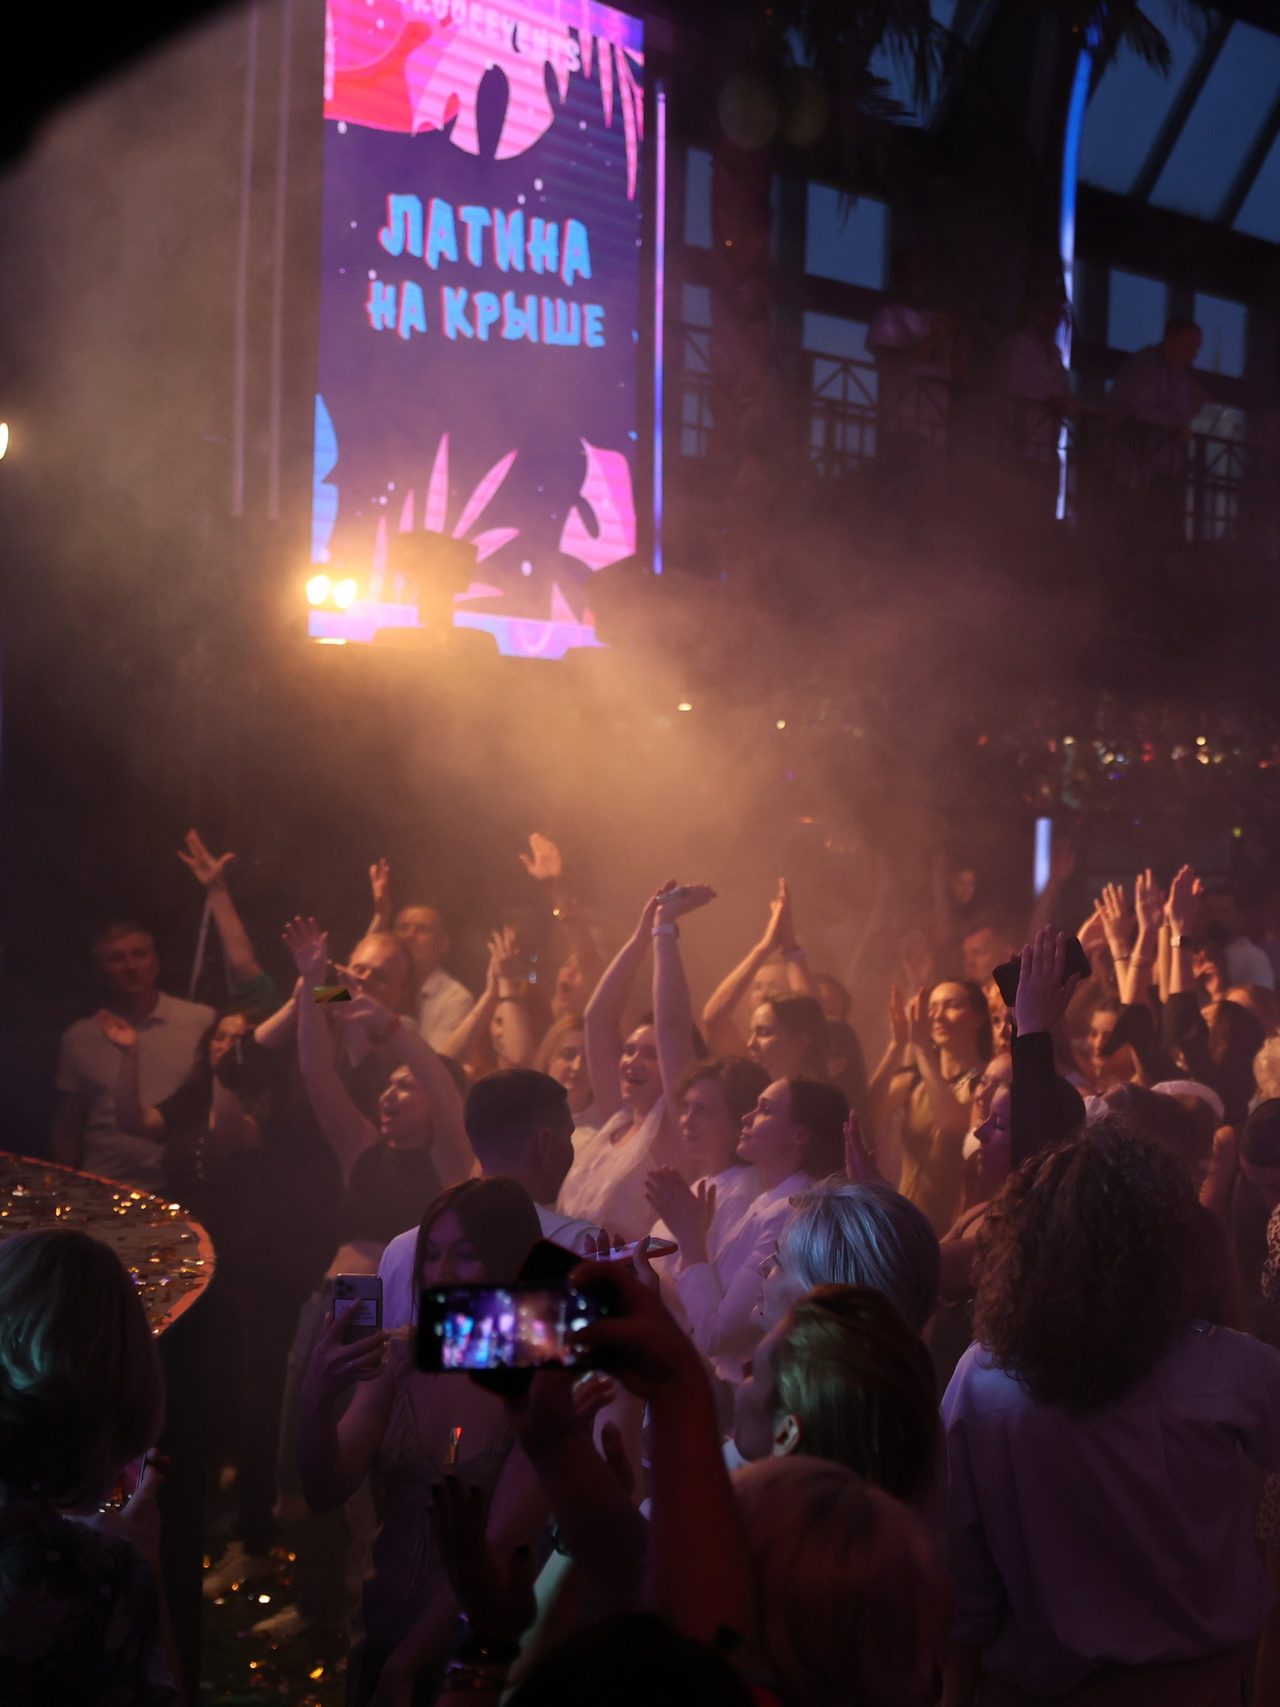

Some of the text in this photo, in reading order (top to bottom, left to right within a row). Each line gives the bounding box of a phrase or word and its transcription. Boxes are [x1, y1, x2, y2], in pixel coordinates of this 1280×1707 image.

[378, 193, 592, 287] ЛАТИНА
[365, 279, 606, 348] НА КРЫШЕ
